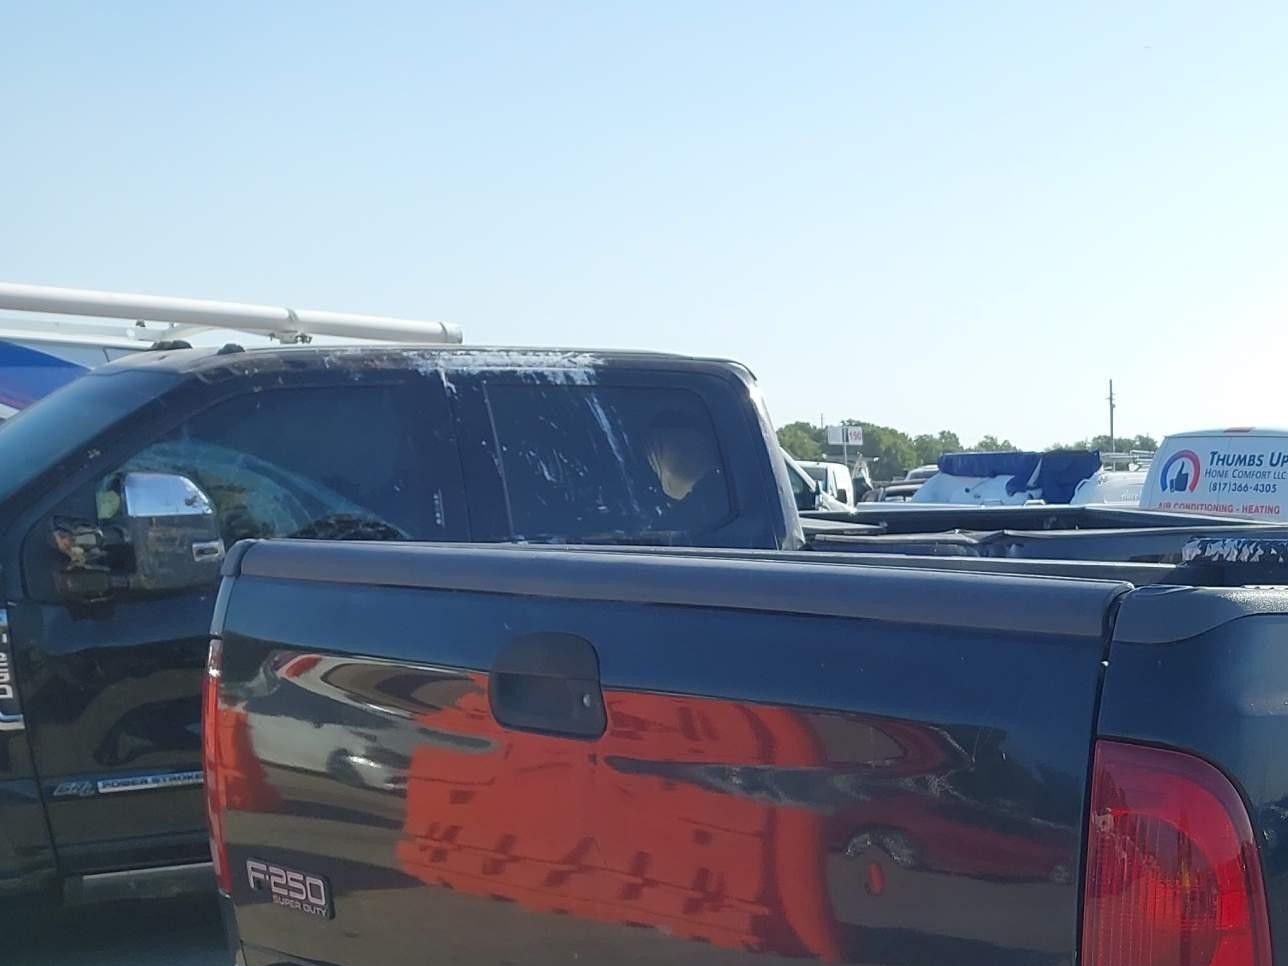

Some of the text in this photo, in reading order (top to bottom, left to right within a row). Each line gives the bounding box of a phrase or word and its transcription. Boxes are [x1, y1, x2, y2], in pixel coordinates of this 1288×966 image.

[1210, 451, 1264, 467] THUMBS
[1205, 468, 1287, 480] HOME COMFORT LLC
[1208, 481, 1277, 493] (817)366-4305
[1173, 502, 1233, 513] CONDITIONING
[1242, 504, 1280, 514] HEATING
[272, 895, 327, 917] SUPER DUTY
